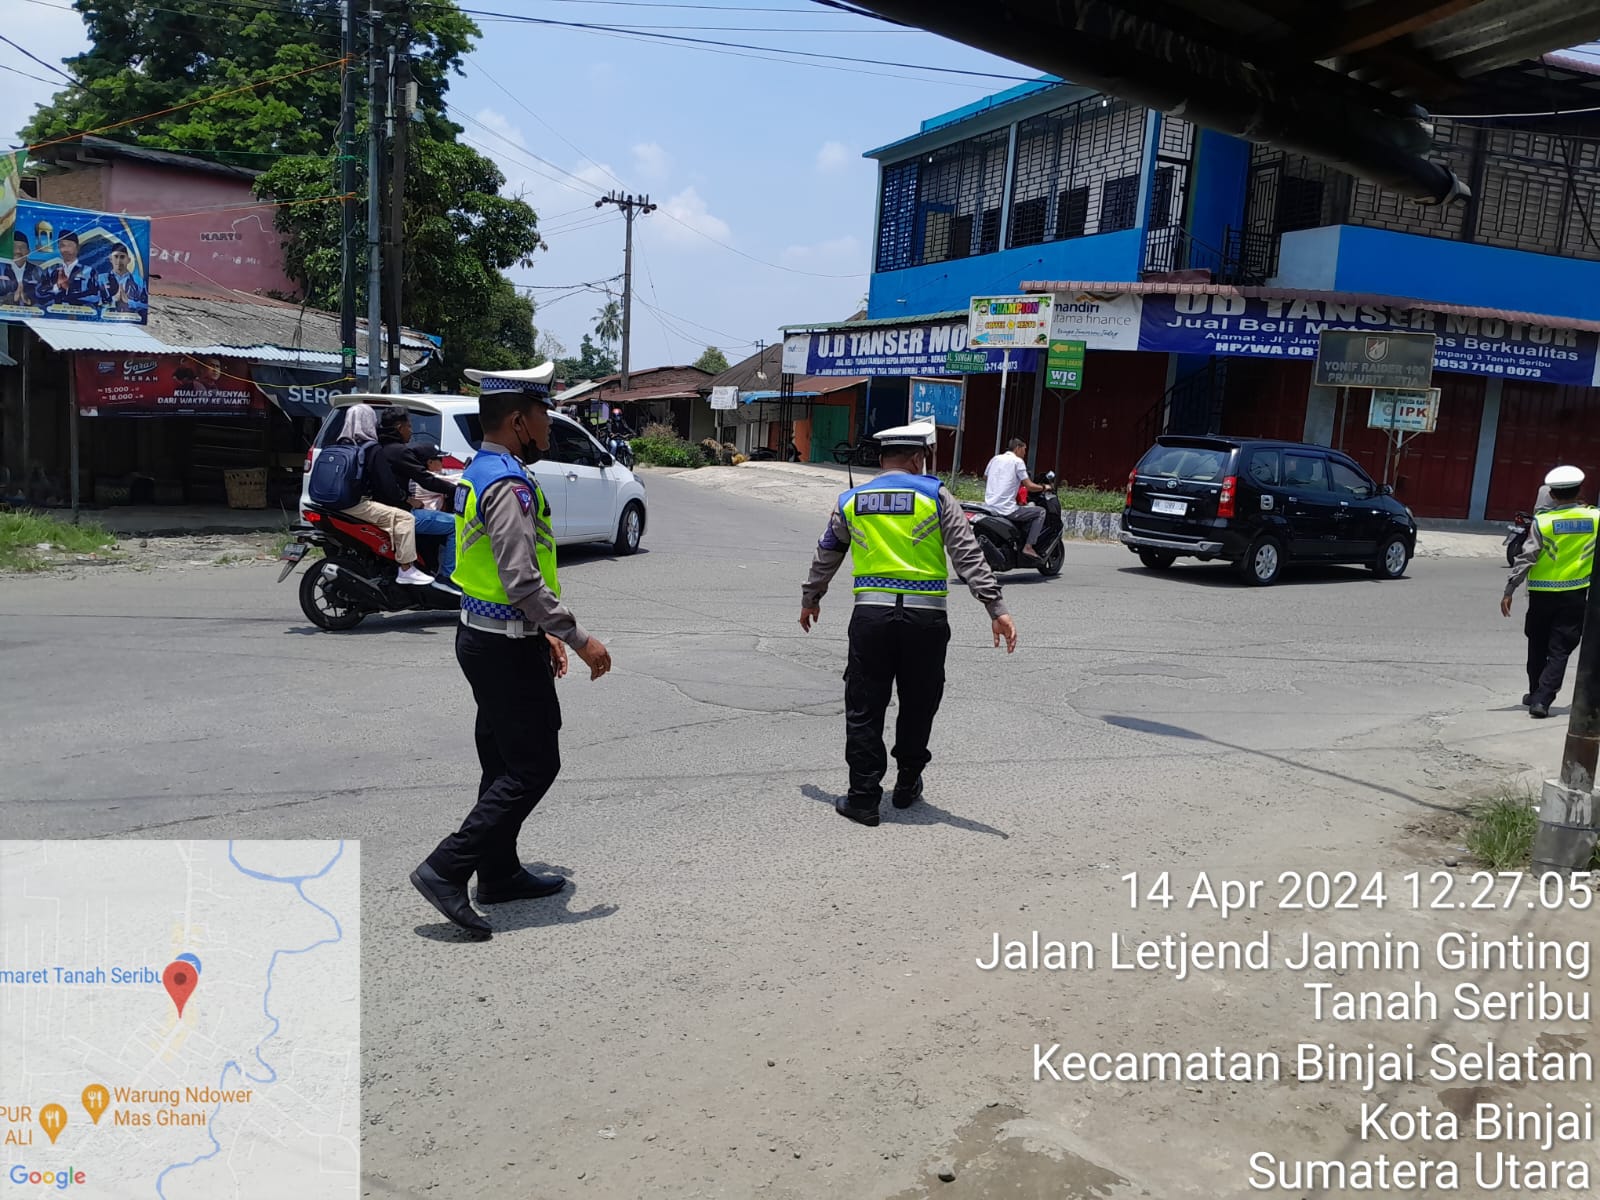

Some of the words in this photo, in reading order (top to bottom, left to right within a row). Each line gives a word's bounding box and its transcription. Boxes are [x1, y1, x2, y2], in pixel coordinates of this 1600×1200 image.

[990, 302, 1040, 315] CHAMPION
[1086, 314, 1131, 326] finance
[1261, 297, 1435, 330] TANSER
[1446, 315, 1577, 348] MOTOR
[818, 334, 846, 358] U.D
[850, 328, 925, 357] TANSER
[1166, 315, 1228, 330] Jual
[1239, 318, 1294, 333] Beli
[1464, 337, 1579, 361] Berkualitas
[1205, 332, 1256, 342] Alamat
[1434, 349, 1473, 360] impang
[1486, 354, 1516, 364] Tanah
[1519, 358, 1551, 368] Seribu
[1215, 342, 1283, 354] HP/WA
[1471, 362, 1503, 374] 7148
[1507, 365, 1541, 377] 0073
[1325, 361, 1358, 371] YONIF
[1361, 362, 1402, 374] RAIDER
[1051, 370, 1077, 382] WJG
[1327, 373, 1384, 384] PRAJURIT
[174, 389, 213, 397] KUALITAS
[1400, 406, 1427, 418] IPK
[857, 493, 912, 512] POLISI
